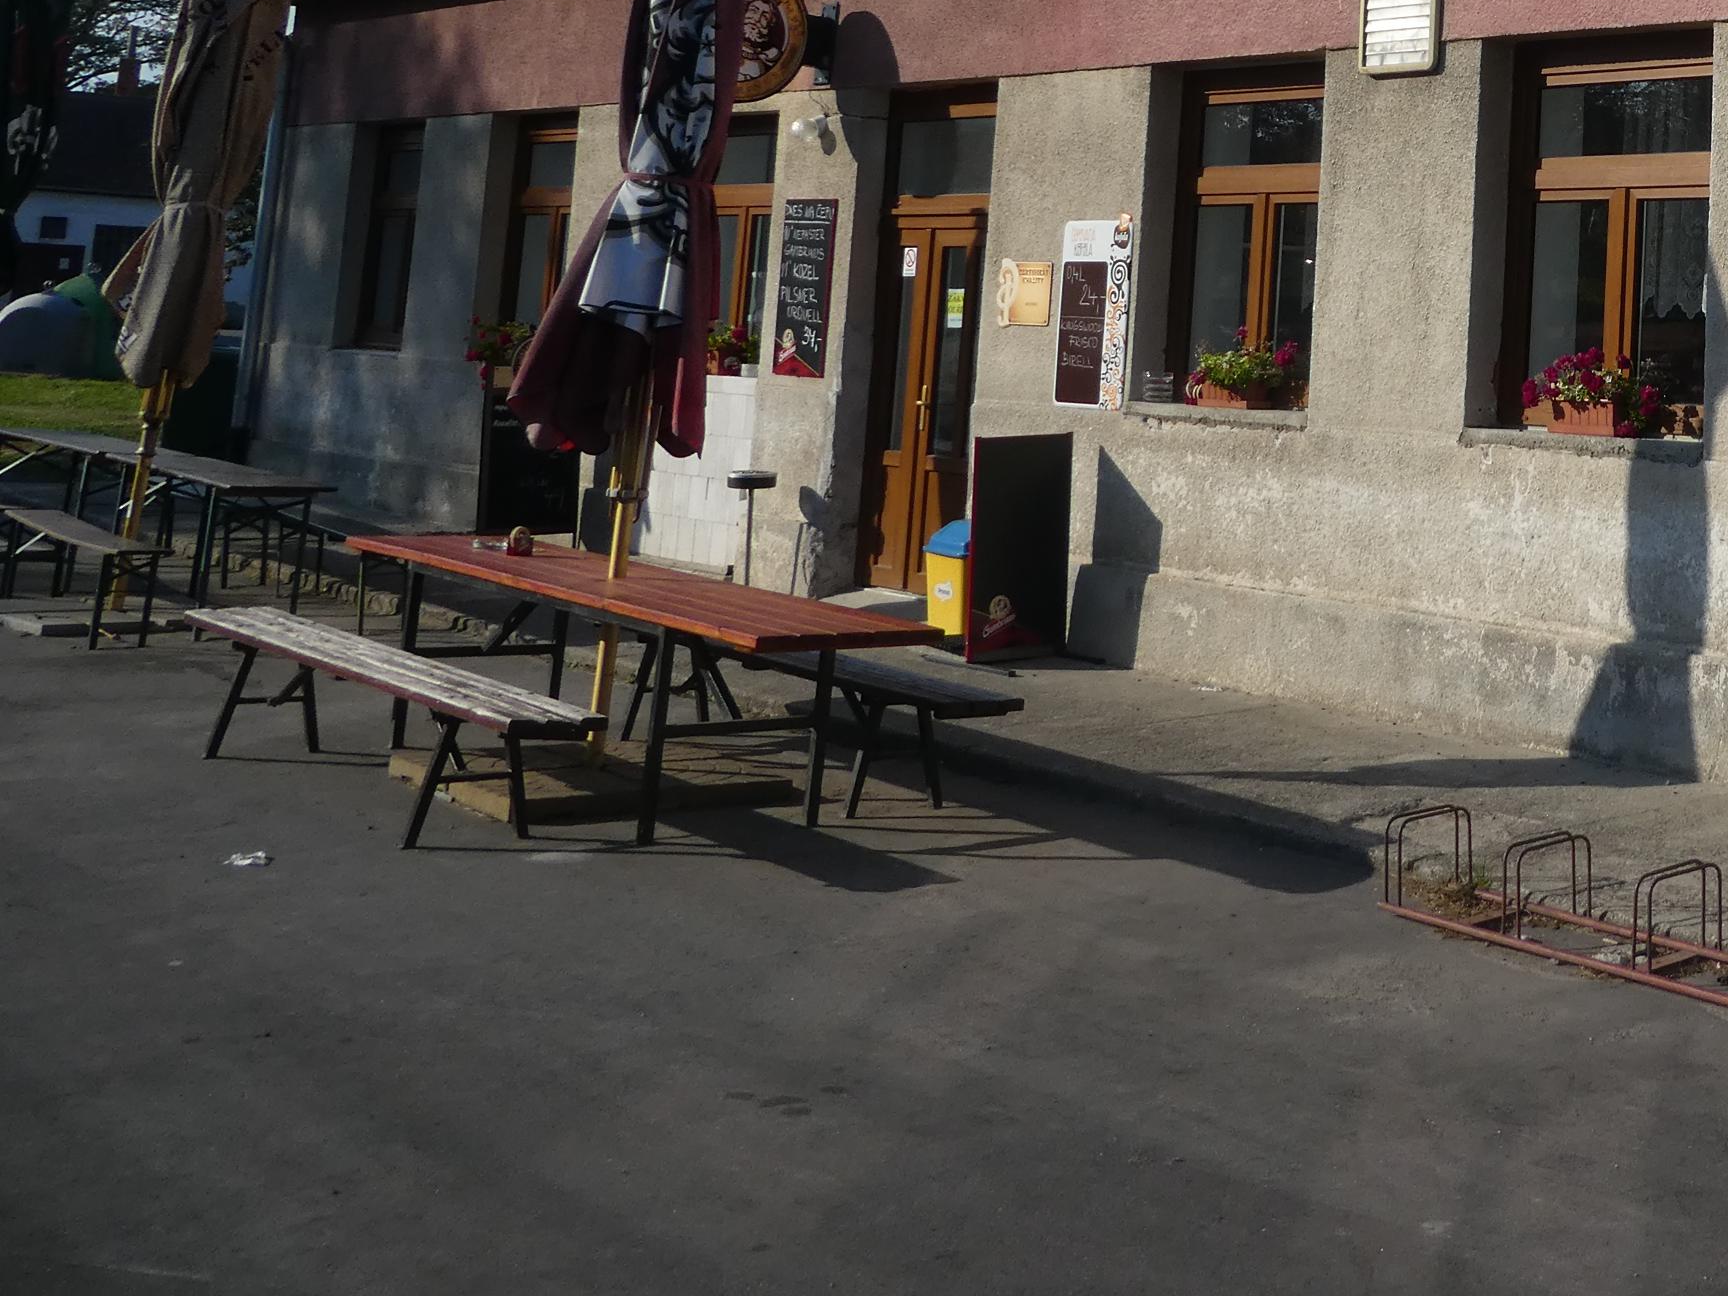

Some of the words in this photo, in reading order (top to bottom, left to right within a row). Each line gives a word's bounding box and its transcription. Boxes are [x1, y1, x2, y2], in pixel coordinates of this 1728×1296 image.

[793, 263, 820, 280] KOZEL
[781, 286, 818, 304] PILSNER
[787, 306, 823, 323] URQUELL
